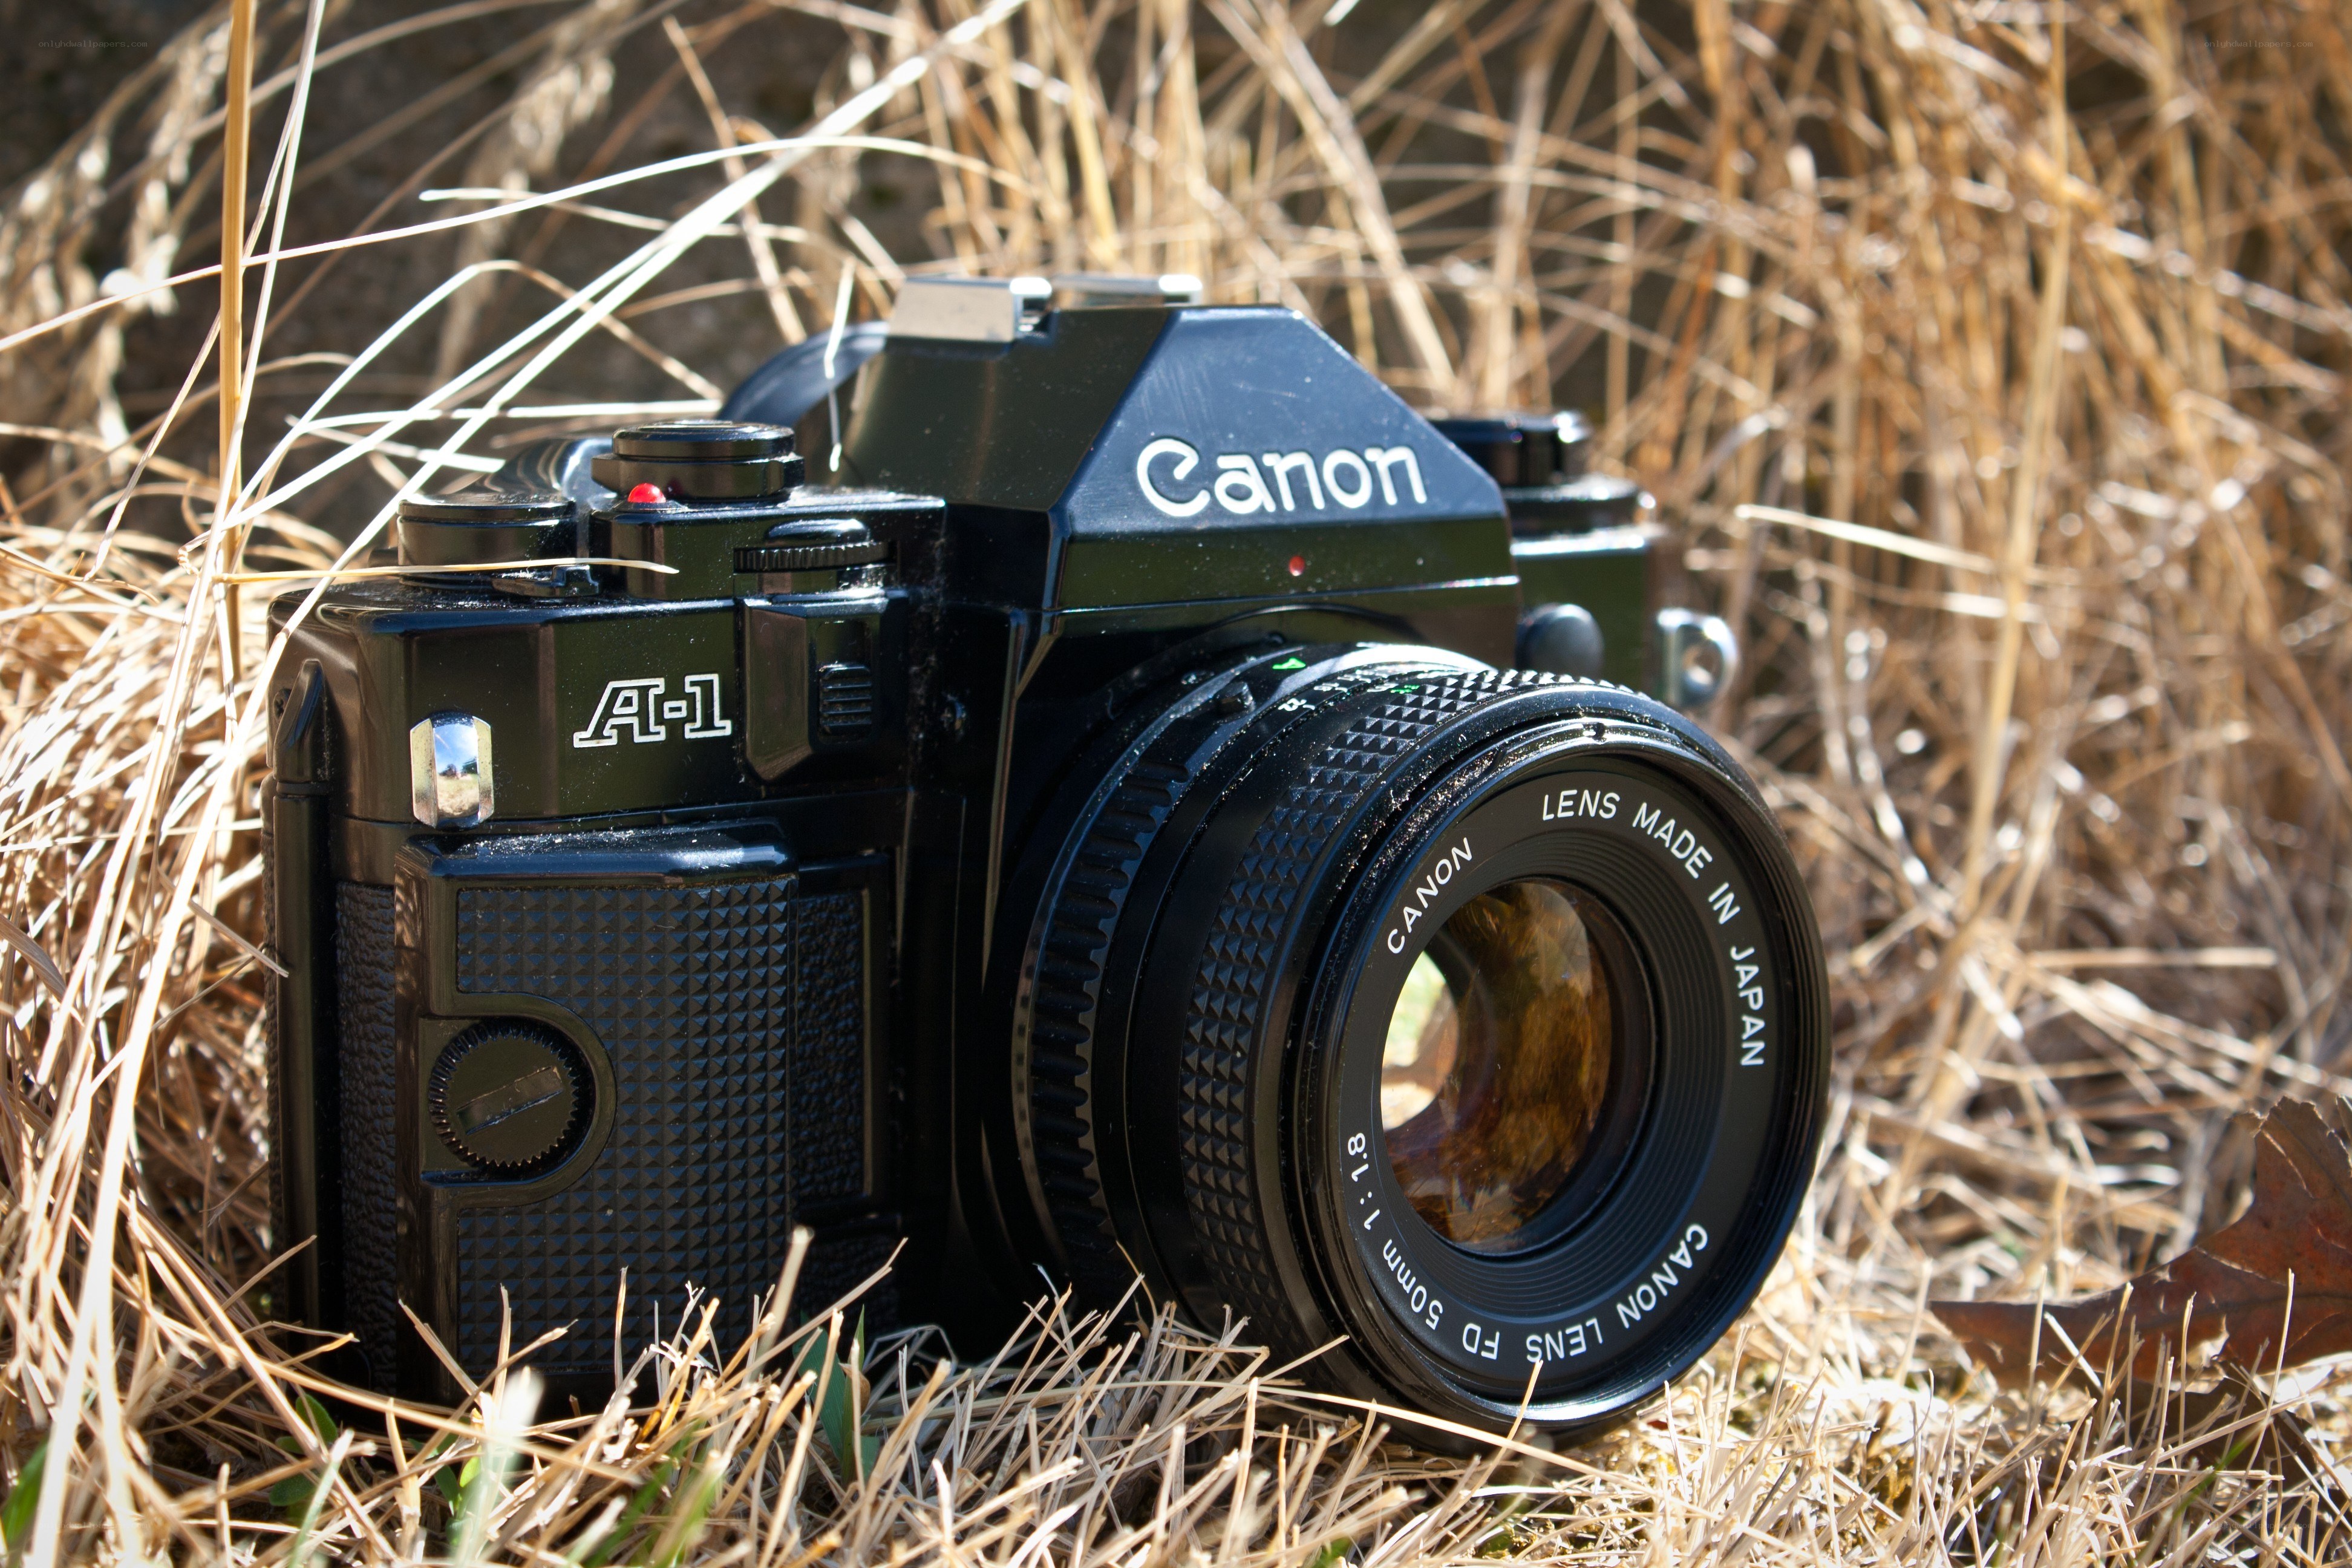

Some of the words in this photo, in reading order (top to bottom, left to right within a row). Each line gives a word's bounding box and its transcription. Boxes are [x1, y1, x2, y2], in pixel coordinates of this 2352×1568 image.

[1137, 438, 1427, 518] Canon
[573, 673, 732, 748] A-1
[1387, 837, 1473, 955] CANON
[1543, 789, 1621, 821] LENS
[1632, 802, 1713, 879] MADE
[1708, 882, 1740, 925] IN
[1730, 946, 1766, 1066] JAPAN
[1383, 1239, 1444, 1330] 50mm
[1617, 1224, 1708, 1329] CANON
[1462, 1322, 1500, 1360] FD
[1526, 1318, 1603, 1362] LENS
